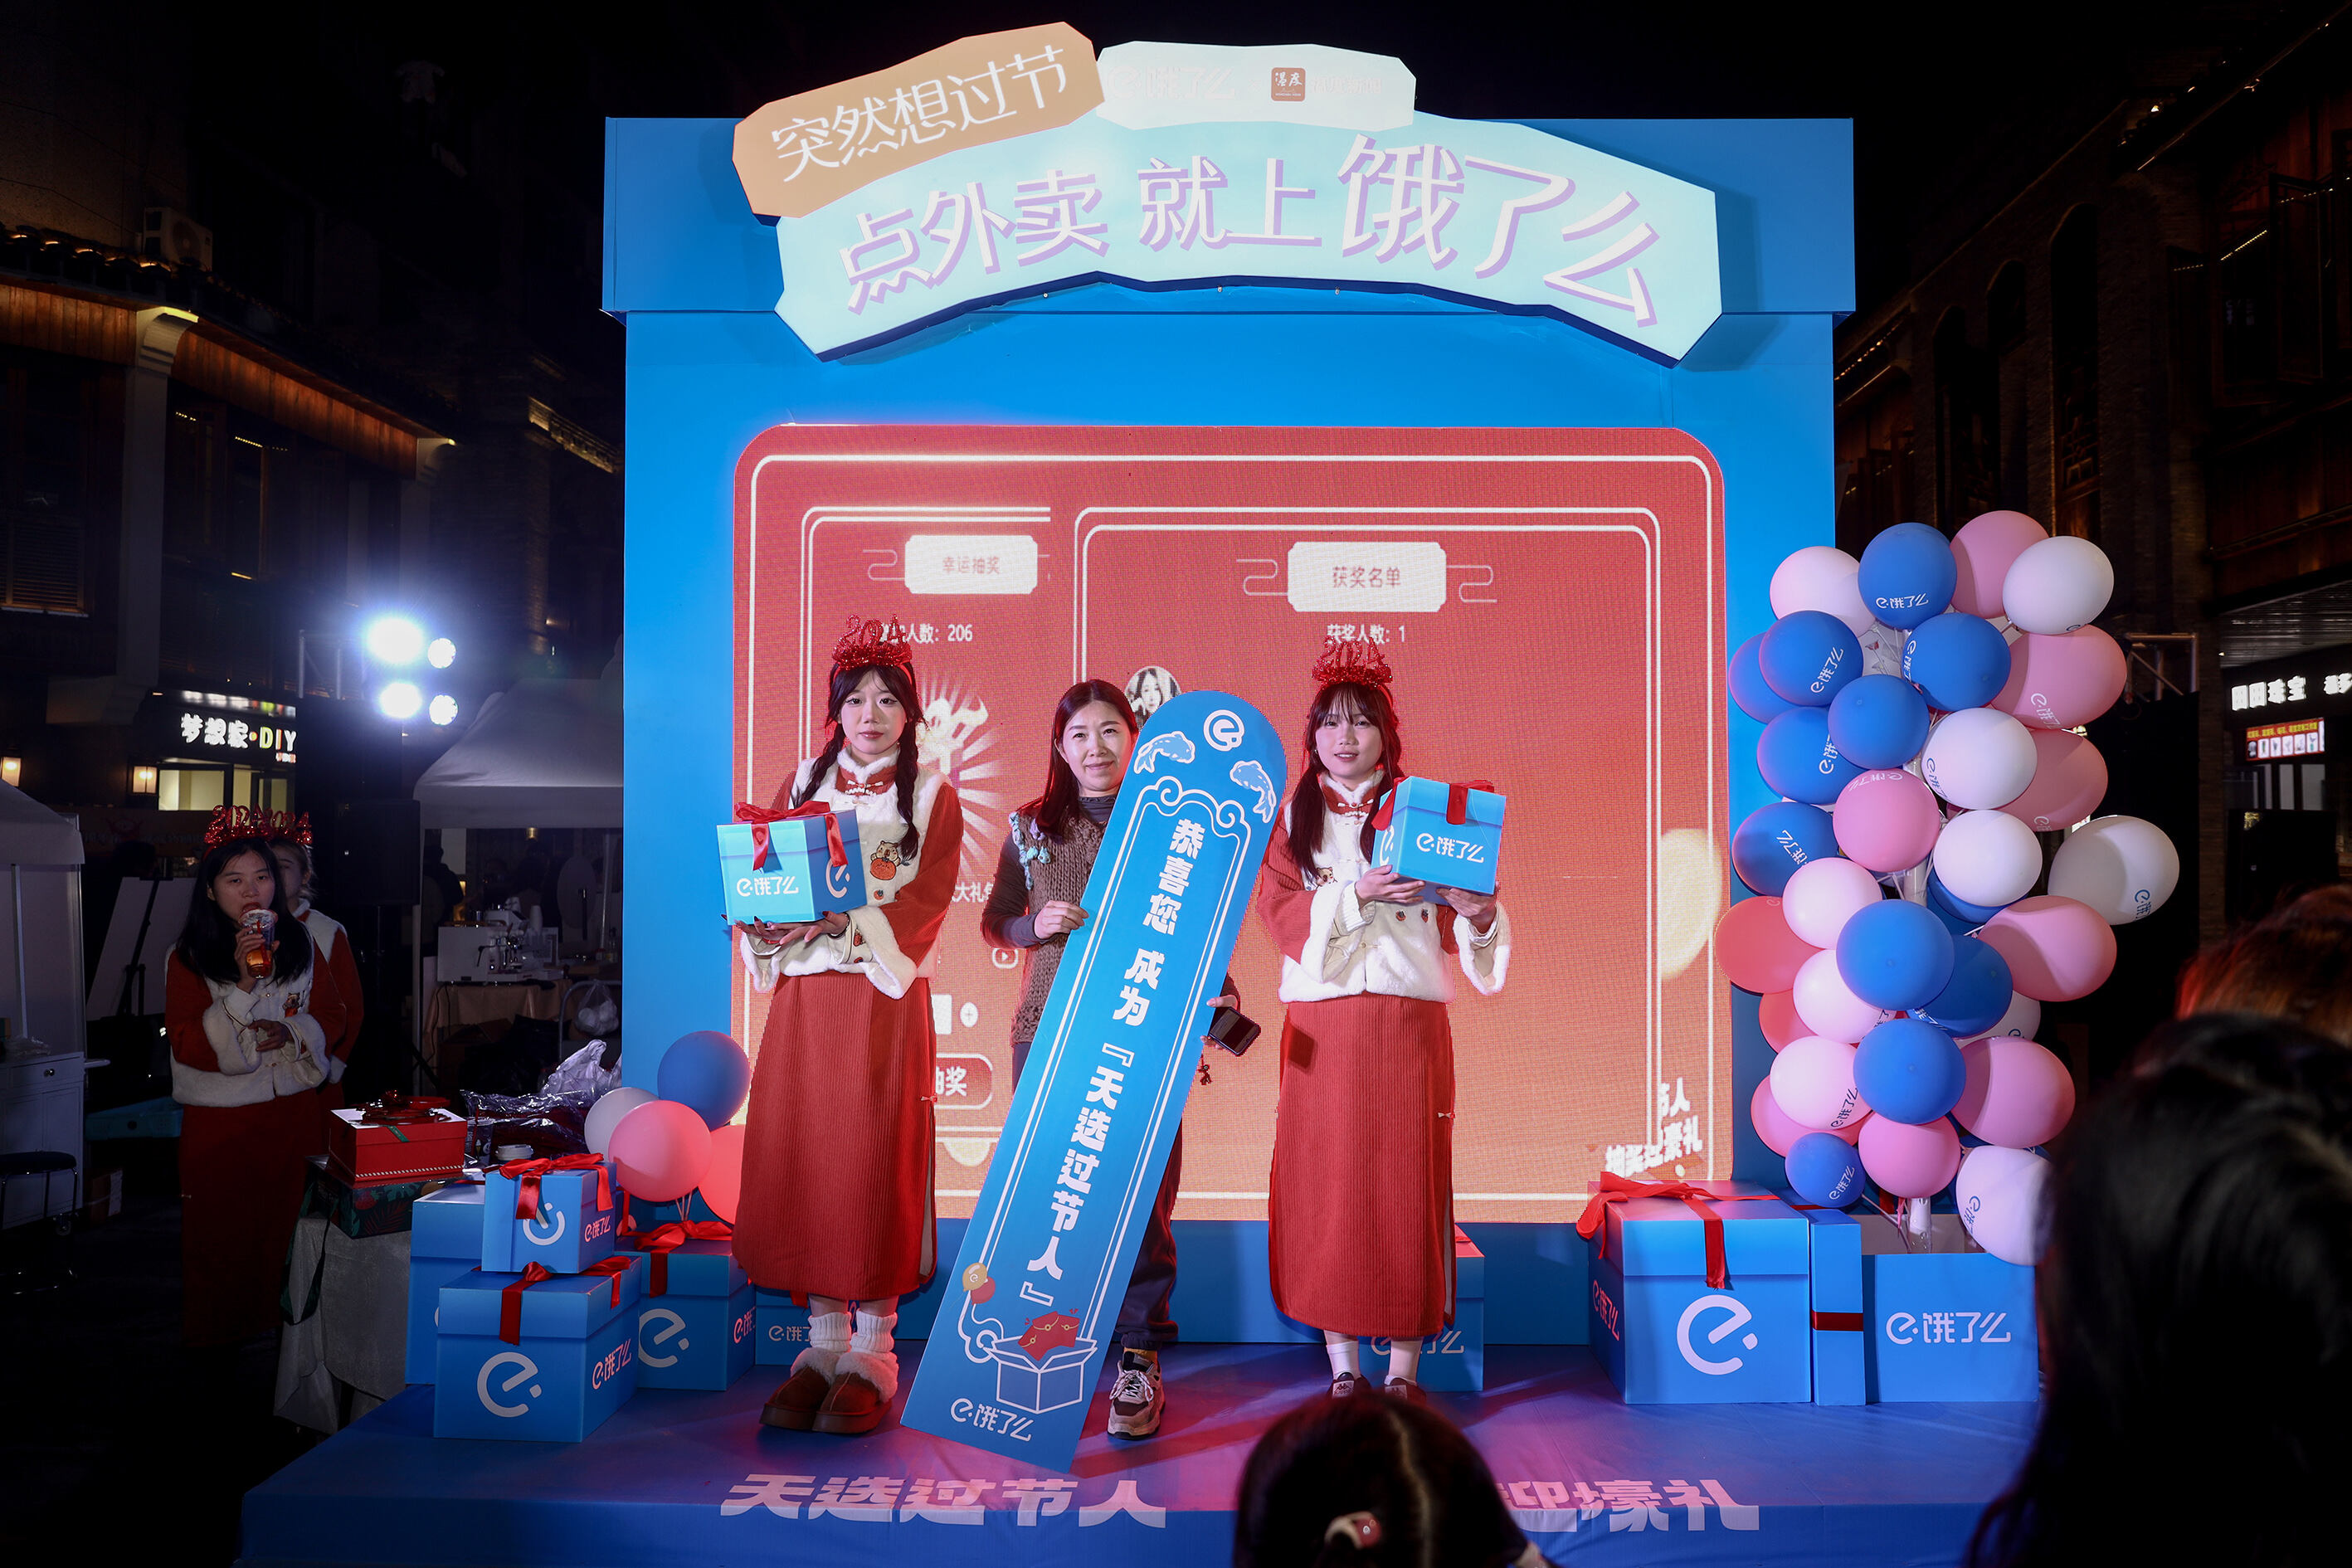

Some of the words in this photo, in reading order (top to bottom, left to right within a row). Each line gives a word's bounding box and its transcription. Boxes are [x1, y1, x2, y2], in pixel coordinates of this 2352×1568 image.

[772, 45, 1067, 183] 突然想过节
[942, 556, 1001, 575] 幸运抽奖
[1332, 565, 1402, 589] 获奖名单
[719, 1473, 1166, 1528] 天选过节人
